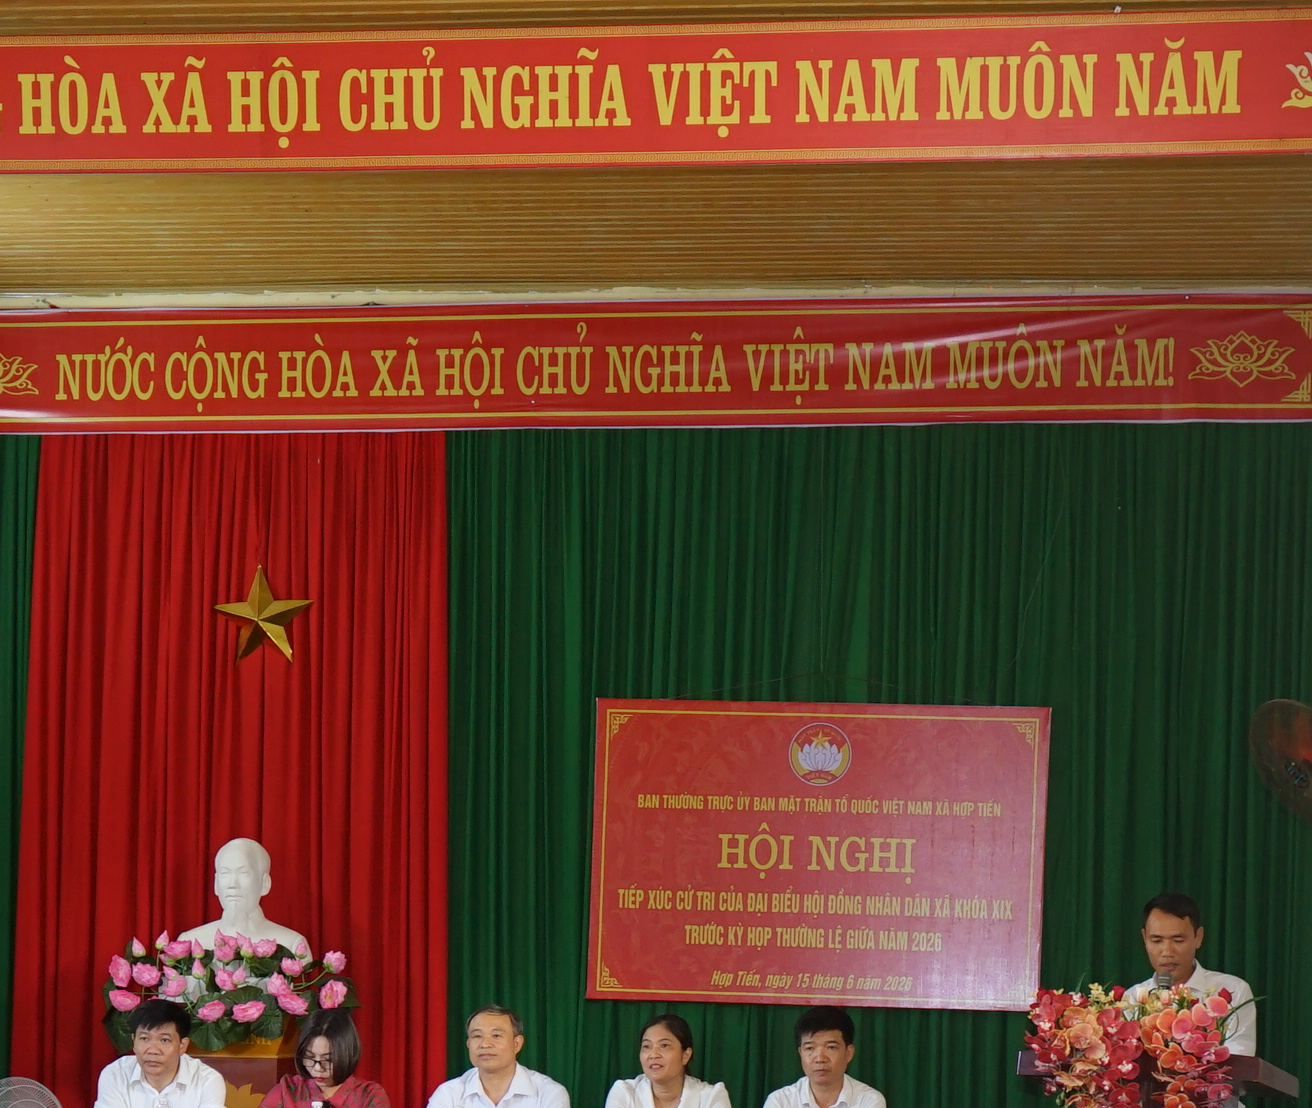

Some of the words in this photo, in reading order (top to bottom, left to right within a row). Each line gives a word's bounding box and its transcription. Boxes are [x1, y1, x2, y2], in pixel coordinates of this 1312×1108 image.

[17, 56, 126, 135] HÒA
[141, 56, 212, 133] XÃ
[227, 57, 320, 148] HỘI
[339, 47, 443, 131] CHỦ
[461, 48, 631, 128] NGHĨA
[648, 48, 777, 137] VIỆT
[796, 58, 919, 122] NAM
[936, 41, 1098, 120] MUÔN
[1115, 38, 1242, 116] NĂM
[55, 337, 155, 402] NƯỚC
[165, 336, 268, 412] CỘNG
[278, 333, 358, 398] HÒA
[369, 336, 425, 396] XÃ
[435, 331, 504, 407] HỘI
[515, 320, 595, 395] CHỦ
[605, 332, 732, 394] NGHĨA
[742, 326, 834, 405] VIỆT
[844, 342, 935, 390] NAM
[946, 323, 1066, 389] MUÔN
[1075, 325, 1175, 387] NĂM!
[637, 794, 660, 809] BAN
[662, 791, 704, 810] THƯỜNG
[707, 794, 734, 813] TRỰC
[737, 791, 750, 811] ỦY
[753, 796, 776, 812] BAN
[778, 794, 801, 815] MẶT
[805, 795, 832, 816] TRẬN
[835, 793, 849, 814] TỔ
[850, 795, 879, 816] QUỐC
[882, 797, 905, 818] VIỆT
[907, 800, 933, 816] NAM
[936, 798, 950, 816] XÃ
[953, 801, 975, 820] HỢP
[977, 798, 1002, 817] TIẾN
[717, 822, 795, 879] HỘI
[806, 836, 917, 884] NGHỊ
[618, 882, 644, 909] TIẾP
[647, 885, 672, 910] XÚC
[676, 884, 695, 911] CỬ
[696, 891, 715, 911] TRI
[719, 886, 744, 912] CỦA
[747, 892, 768, 916] ĐẠI
[771, 885, 801, 914] BIỂU
[803, 891, 824, 919] HỘI
[828, 888, 862, 916] ĐỒNG
[866, 891, 901, 917] NHÂN
[905, 893, 930, 917] DÂN
[933, 894, 951, 918] XÃ
[954, 894, 988, 919] KHÓA
[992, 900, 1013, 920] XIX
[684, 921, 725, 946] TRƯỚC
[728, 922, 744, 946] KỲ
[747, 927, 772, 951] HỌP
[776, 924, 825, 949] THƯỜNG
[828, 924, 843, 953] LỆ
[846, 927, 875, 950] GIỮA
[879, 927, 908, 951] NĂM
[912, 932, 942, 952] 2026
[711, 970, 734, 989] Hợp
[736, 969, 762, 988] Tiến,
[765, 972, 794, 990] ngày
[797, 973, 810, 988] 15
[812, 973, 843, 991] tháng
[846, 976, 854, 989] 6
[857, 977, 882, 990] năm
[884, 976, 913, 990] 2026
